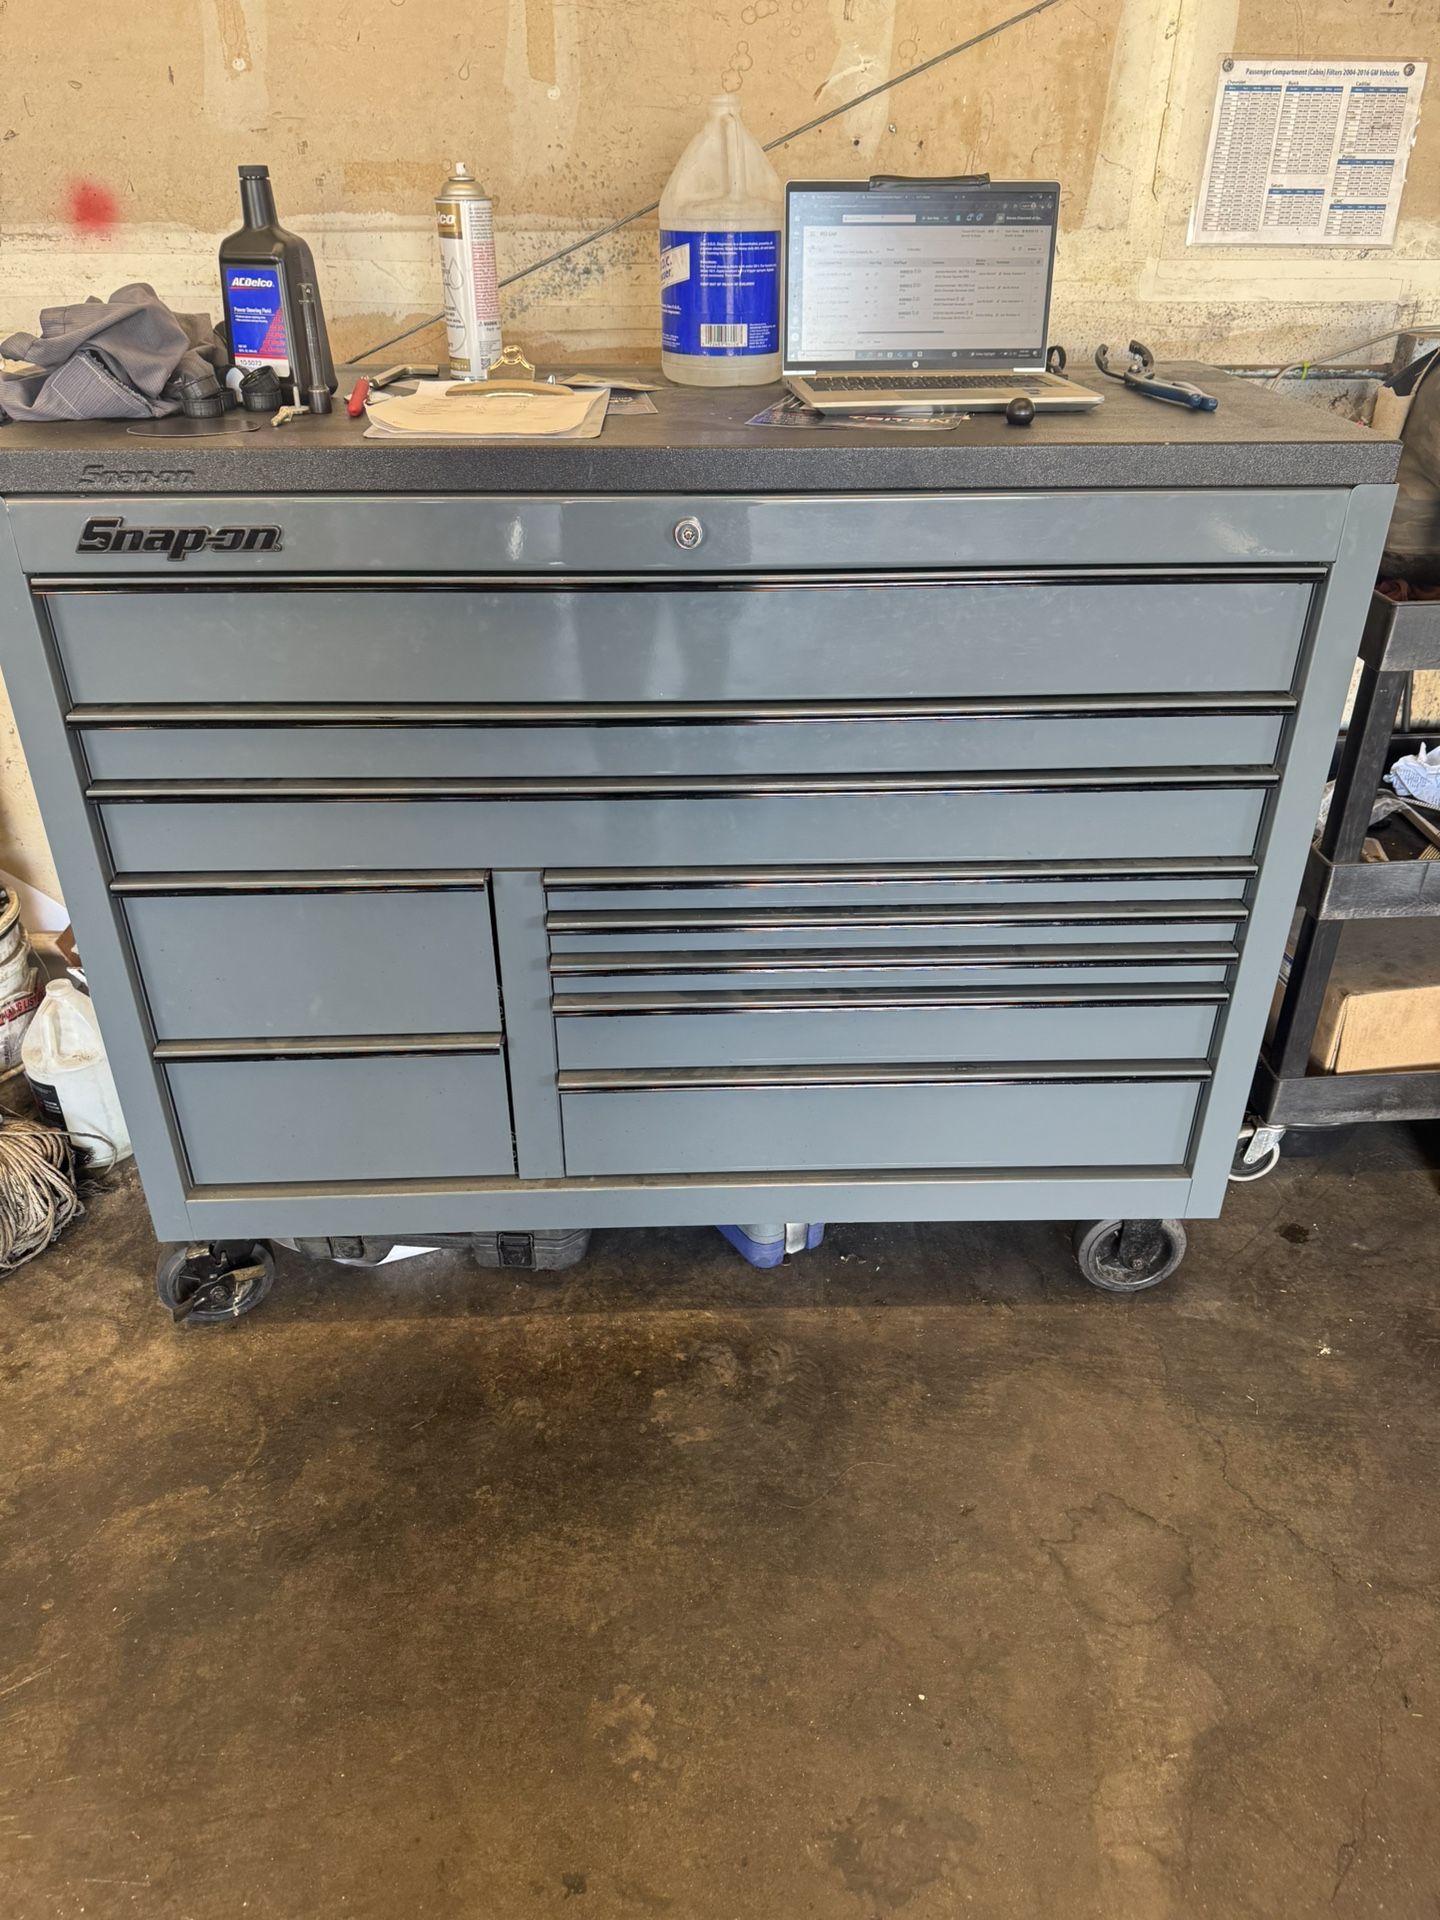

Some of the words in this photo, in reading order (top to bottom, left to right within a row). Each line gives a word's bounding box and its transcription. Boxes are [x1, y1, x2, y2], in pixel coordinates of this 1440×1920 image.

[1245, 68, 1271, 77] Passenger
[1272, 68, 1307, 77] Compartment
[1308, 68, 1326, 77] (Cabin)
[1379, 69, 1400, 77] Vehicles
[232, 277, 274, 288] ACDelco
[78, 464, 196, 487] Snap-on
[76, 516, 282, 561] Snap-on
